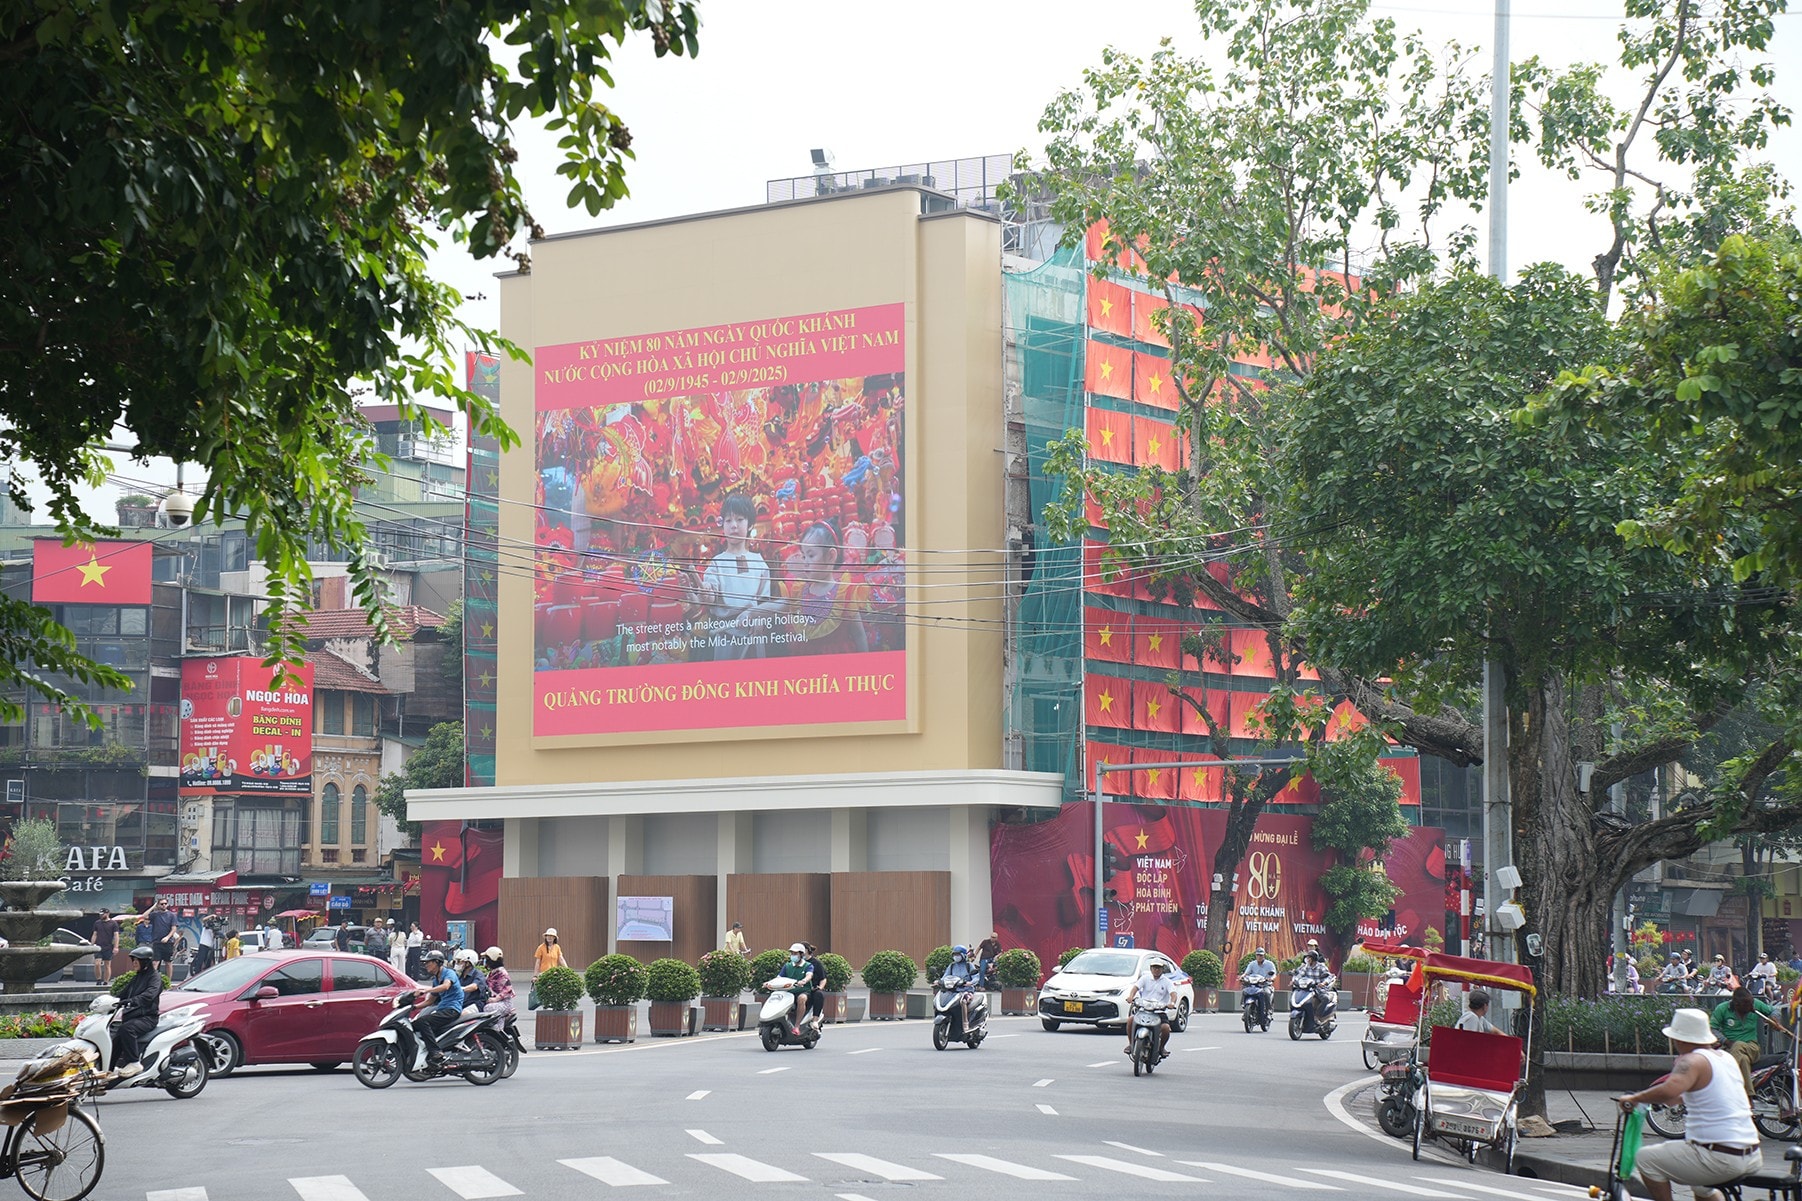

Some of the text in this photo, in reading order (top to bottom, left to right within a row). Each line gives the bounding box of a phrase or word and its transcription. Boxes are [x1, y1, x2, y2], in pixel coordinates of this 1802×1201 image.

[579, 312, 856, 360] KỶ NIỆM 80 NĂM NGÀY QUỐC KHÁNH
[544, 330, 899, 385] NƯỚC CỘNG HÒA XÃ HỘI CHỦ NGHĨA VIỆT NAM
[644, 374, 709, 397] (02/9/1945
[721, 365, 788, 387] 02/9/2025)
[616, 624, 634, 635] The
[636, 622, 662, 635] street
[665, 620, 684, 636] gets
[686, 622, 692, 631] a
[694, 617, 740, 631] makeover
[742, 615, 772, 630] during
[626, 640, 650, 652] most
[651, 637, 687, 653] notably
[690, 636, 705, 648] the
[708, 633, 768, 647] Mid-Autumn
[246, 690, 309, 705] NGỌC HOA
[544, 673, 895, 710] QUẢNG TRƯỜNG ĐÔNG KINH NGHĨA THỤC
[253, 714, 302, 726] BĂNG DÍNH
[253, 726, 282, 736] DECAL
[291, 729, 301, 737] IN
[1254, 830, 1275, 843] MỪNG
[1276, 834, 1288, 847] ĐẠI
[1289, 830, 1299, 845] LỄ
[1137, 855, 1172, 870] VIỆT NAM
[1137, 870, 1168, 886] ĐỘC LẬP
[1247, 851, 1281, 900] 80
[58, 876, 103, 892] Café
[1137, 885, 1171, 898] HOÀ BÌNH
[175, 893, 189, 906] FREE
[189, 892, 203, 906] DATA
[1135, 899, 1178, 913] PHÁT TRIỂN
[1196, 902, 1208, 915] TÔI
[1239, 902, 1285, 918] QUỐC KHÁNH
[1196, 917, 1208, 931] VIỆ
[1245, 918, 1262, 933] VIỆT
[1263, 921, 1280, 932] NAM
[1293, 923, 1326, 935] VIETNAM
[1357, 923, 1373, 937] HÀO
[1394, 923, 1408, 938] TỘC
[1118, 936, 1129, 947] G7
